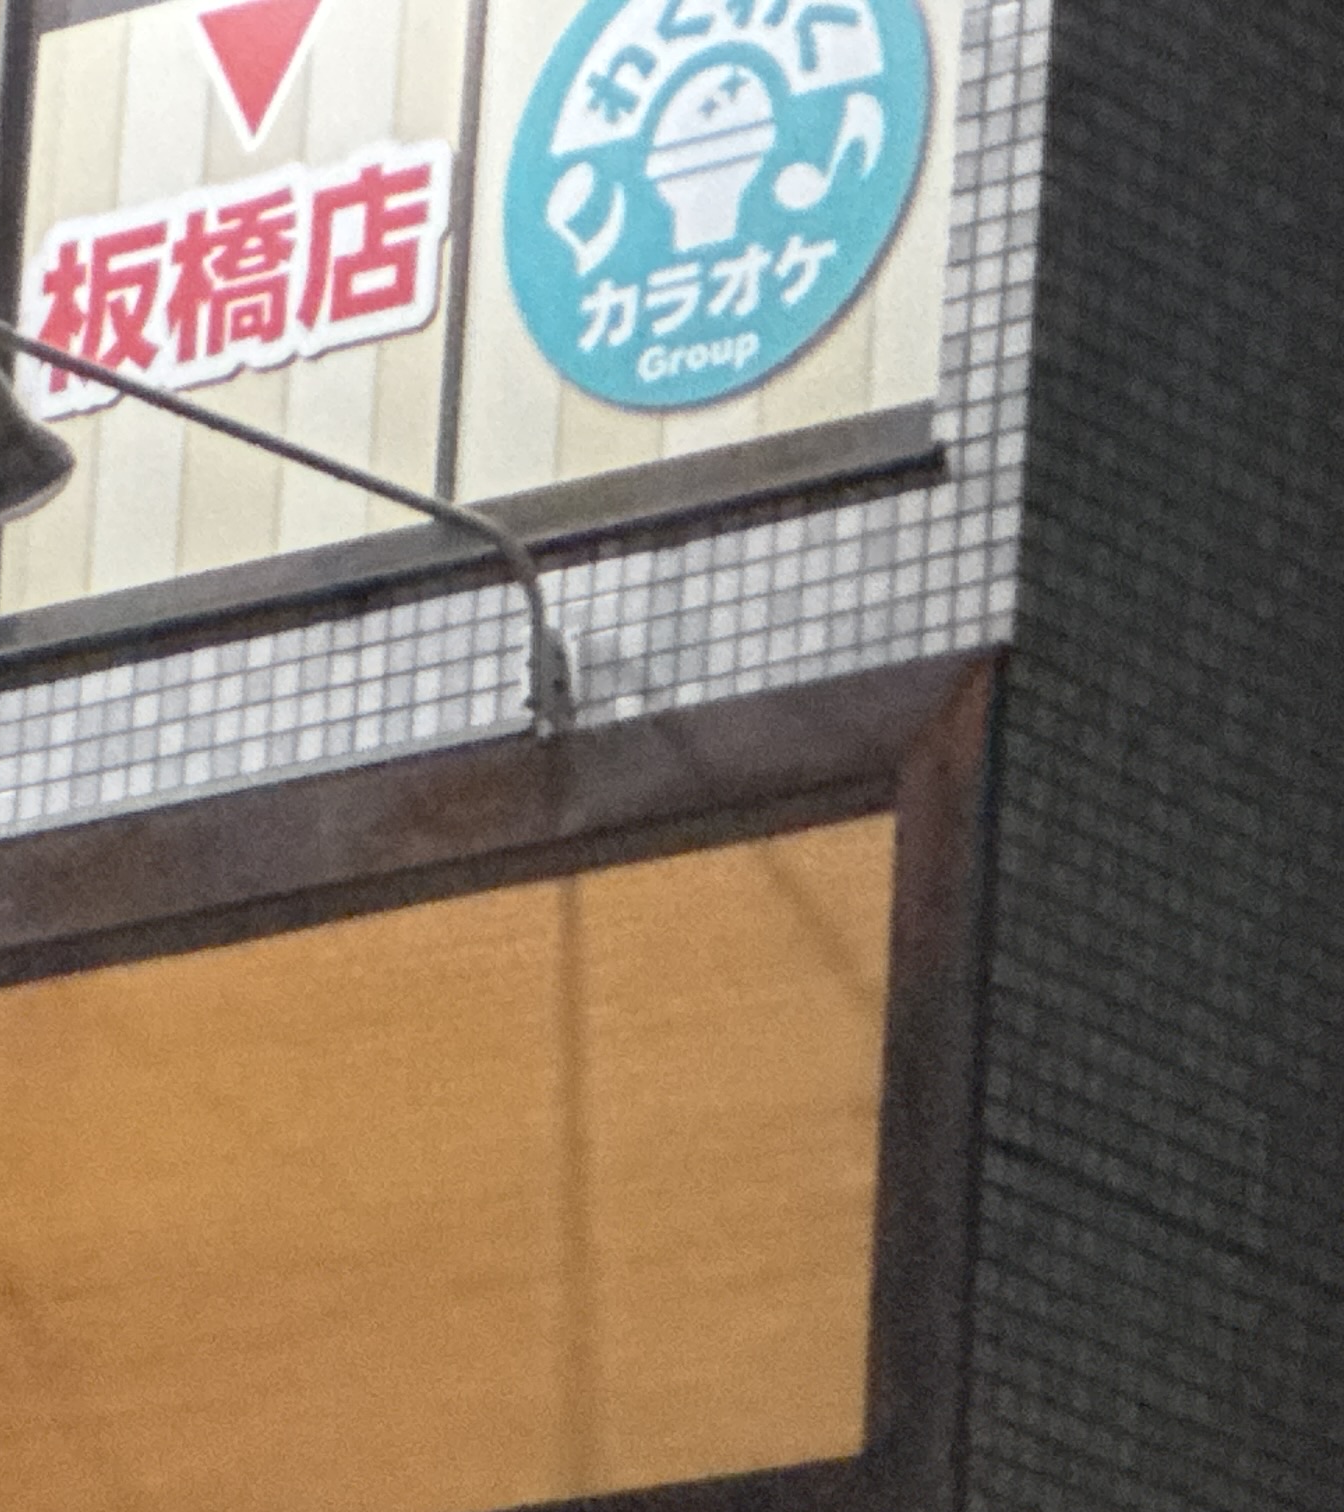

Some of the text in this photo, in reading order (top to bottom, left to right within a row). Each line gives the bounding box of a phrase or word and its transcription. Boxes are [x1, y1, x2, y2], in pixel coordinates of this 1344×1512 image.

[41, 163, 431, 392] 板橋店
[577, 235, 837, 353] カラオケ
[637, 333, 761, 385] Group
